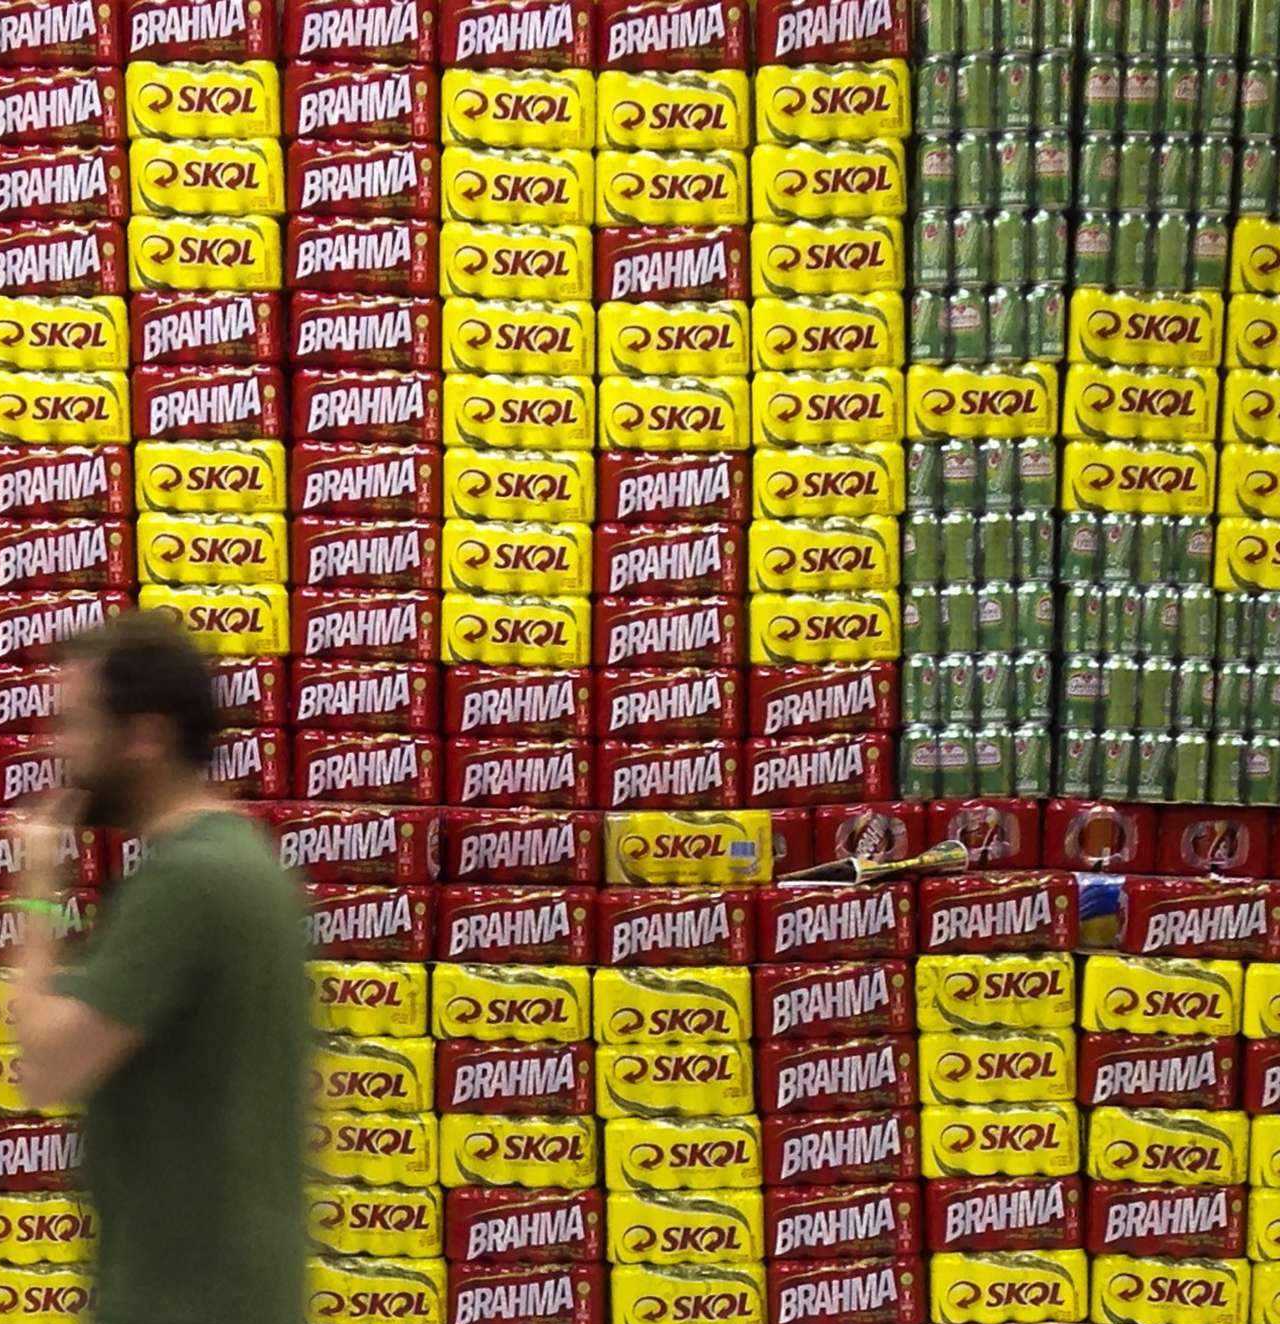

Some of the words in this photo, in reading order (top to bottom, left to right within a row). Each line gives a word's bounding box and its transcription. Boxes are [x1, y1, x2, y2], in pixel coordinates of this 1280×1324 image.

[130, 0, 246, 53] BRAHMA
[456, 1, 573, 61] BRAHMA
[776, 0, 892, 57] BRAHMA
[180, 87, 255, 114] SKOL
[298, 73, 412, 135] BRAHMA
[494, 94, 568, 123] SKOL
[811, 86, 888, 114] SKOL
[650, 175, 727, 201] SKOL
[181, 238, 254, 266] SKOL
[296, 225, 411, 279] BRAHMA
[611, 241, 727, 299] BRAHMA
[1125, 314, 1200, 344] SKOL
[150, 376, 261, 436] BRAHMA
[649, 406, 724, 431] SKOL
[960, 390, 1036, 416] SKOL
[187, 466, 262, 491] SKOL
[1119, 466, 1196, 493] SKOL
[308, 530, 420, 584] BRAHMA
[610, 534, 721, 593] BRAHMA
[492, 619, 566, 646] SKOL
[806, 614, 880, 640] SKOL
[297, 672, 410, 720] BRAHMA
[764, 672, 876, 735] BRAHMA
[459, 823, 575, 875] BRAHMA
[653, 835, 725, 859] SKOL
[775, 891, 895, 953] BRAHMA
[1142, 899, 1267, 952] BRAHMA
[984, 970, 1063, 999] SKOL
[487, 998, 567, 1025] SKOL
[452, 1053, 575, 1105] BRAHMA
[777, 1046, 896, 1109] BRAHMA
[1092, 1051, 1216, 1104] BRAHMA
[670, 1141, 748, 1167] SKOL
[981, 1123, 1059, 1151] SKOL
[774, 1198, 895, 1255] BRAHMA
[1104, 1188, 1227, 1243] BRAHMA
[674, 1293, 752, 1320] SKOL
[1148, 1277, 1227, 1307] SKOL
